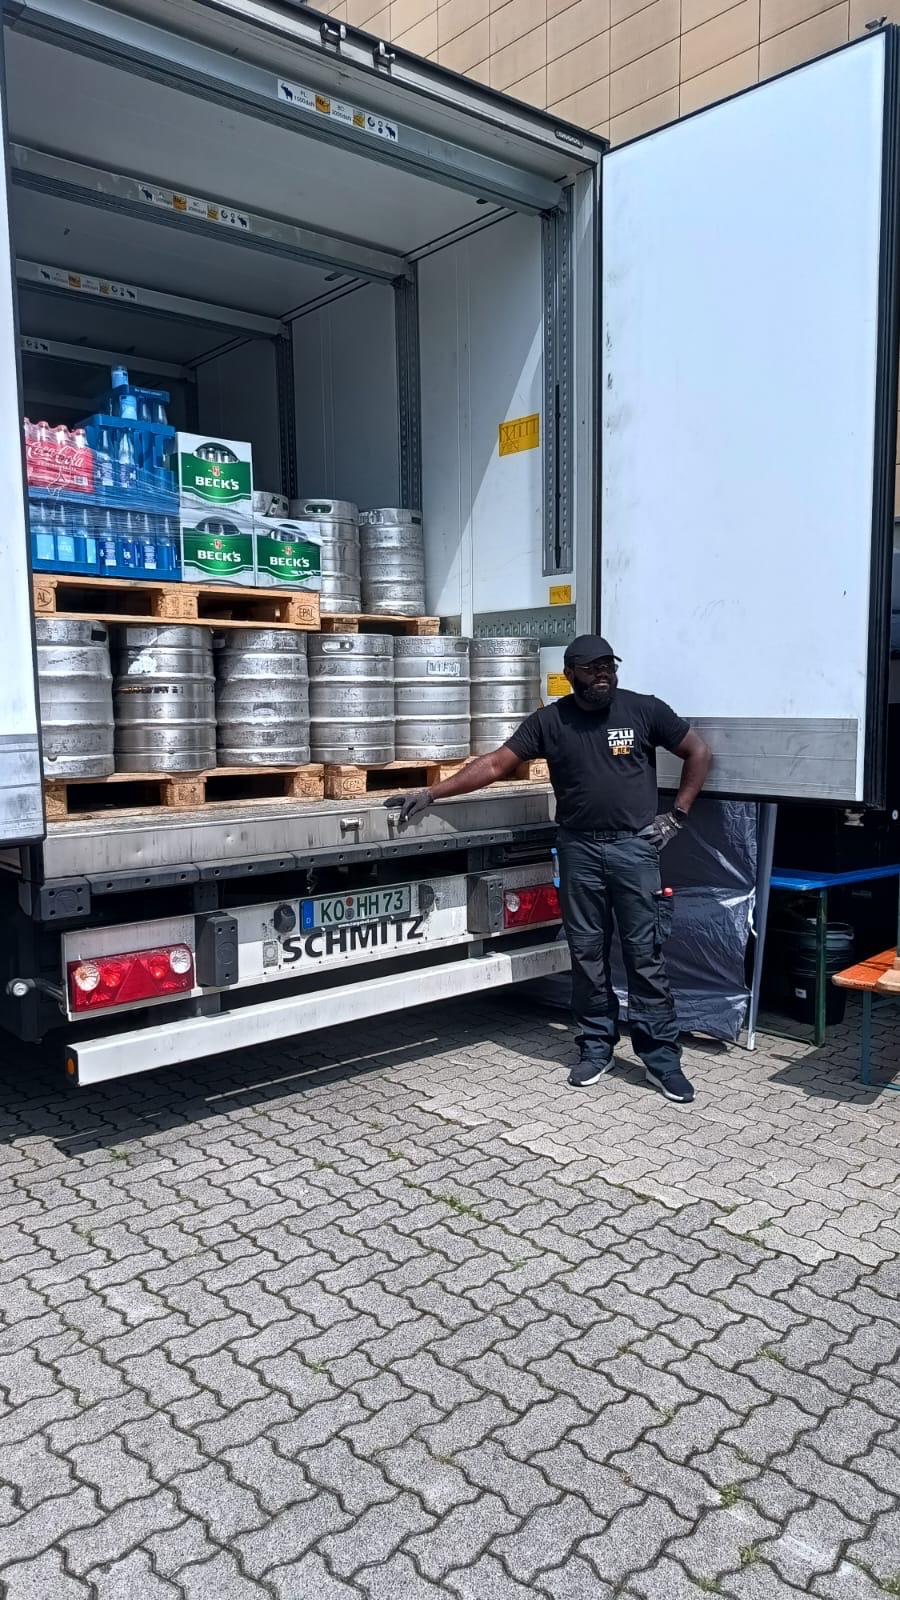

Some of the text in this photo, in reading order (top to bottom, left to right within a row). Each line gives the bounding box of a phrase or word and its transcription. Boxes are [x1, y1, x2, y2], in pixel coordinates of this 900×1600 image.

[195, 475, 240, 490] BECK'S
[197, 550, 241, 563] BECK'S
[269, 556, 310, 568] BECK'S
[608, 739, 635, 747] UNIT
[321, 900, 345, 923] KO
[357, 894, 380, 917] HH
[383, 890, 404, 912] 73
[283, 915, 424, 963] SCHMITZ
